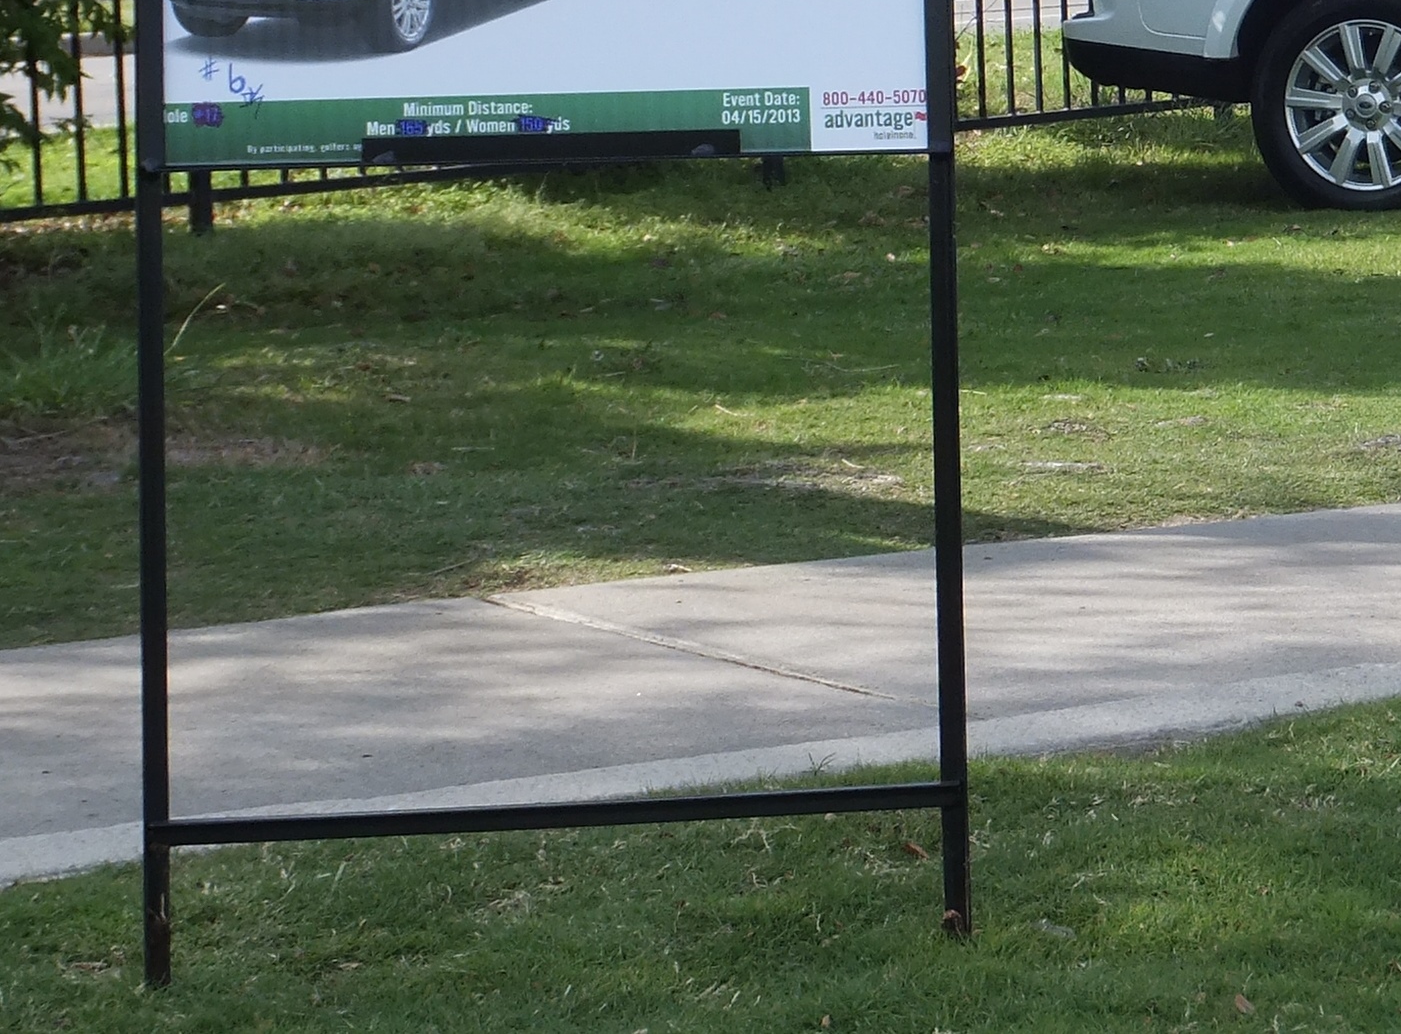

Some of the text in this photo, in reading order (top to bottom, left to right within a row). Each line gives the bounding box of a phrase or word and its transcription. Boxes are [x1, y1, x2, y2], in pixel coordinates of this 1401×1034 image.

[723, 90, 800, 107] Event Date:
[823, 89, 926, 106] 800-440-5070
[164, 109, 188, 123] ole
[404, 99, 533, 117] Minimum Distance:
[722, 109, 800, 125] 04/15/2013
[825, 109, 913, 130] advantage
[367, 121, 395, 136] Men
[467, 118, 515, 134] Women
